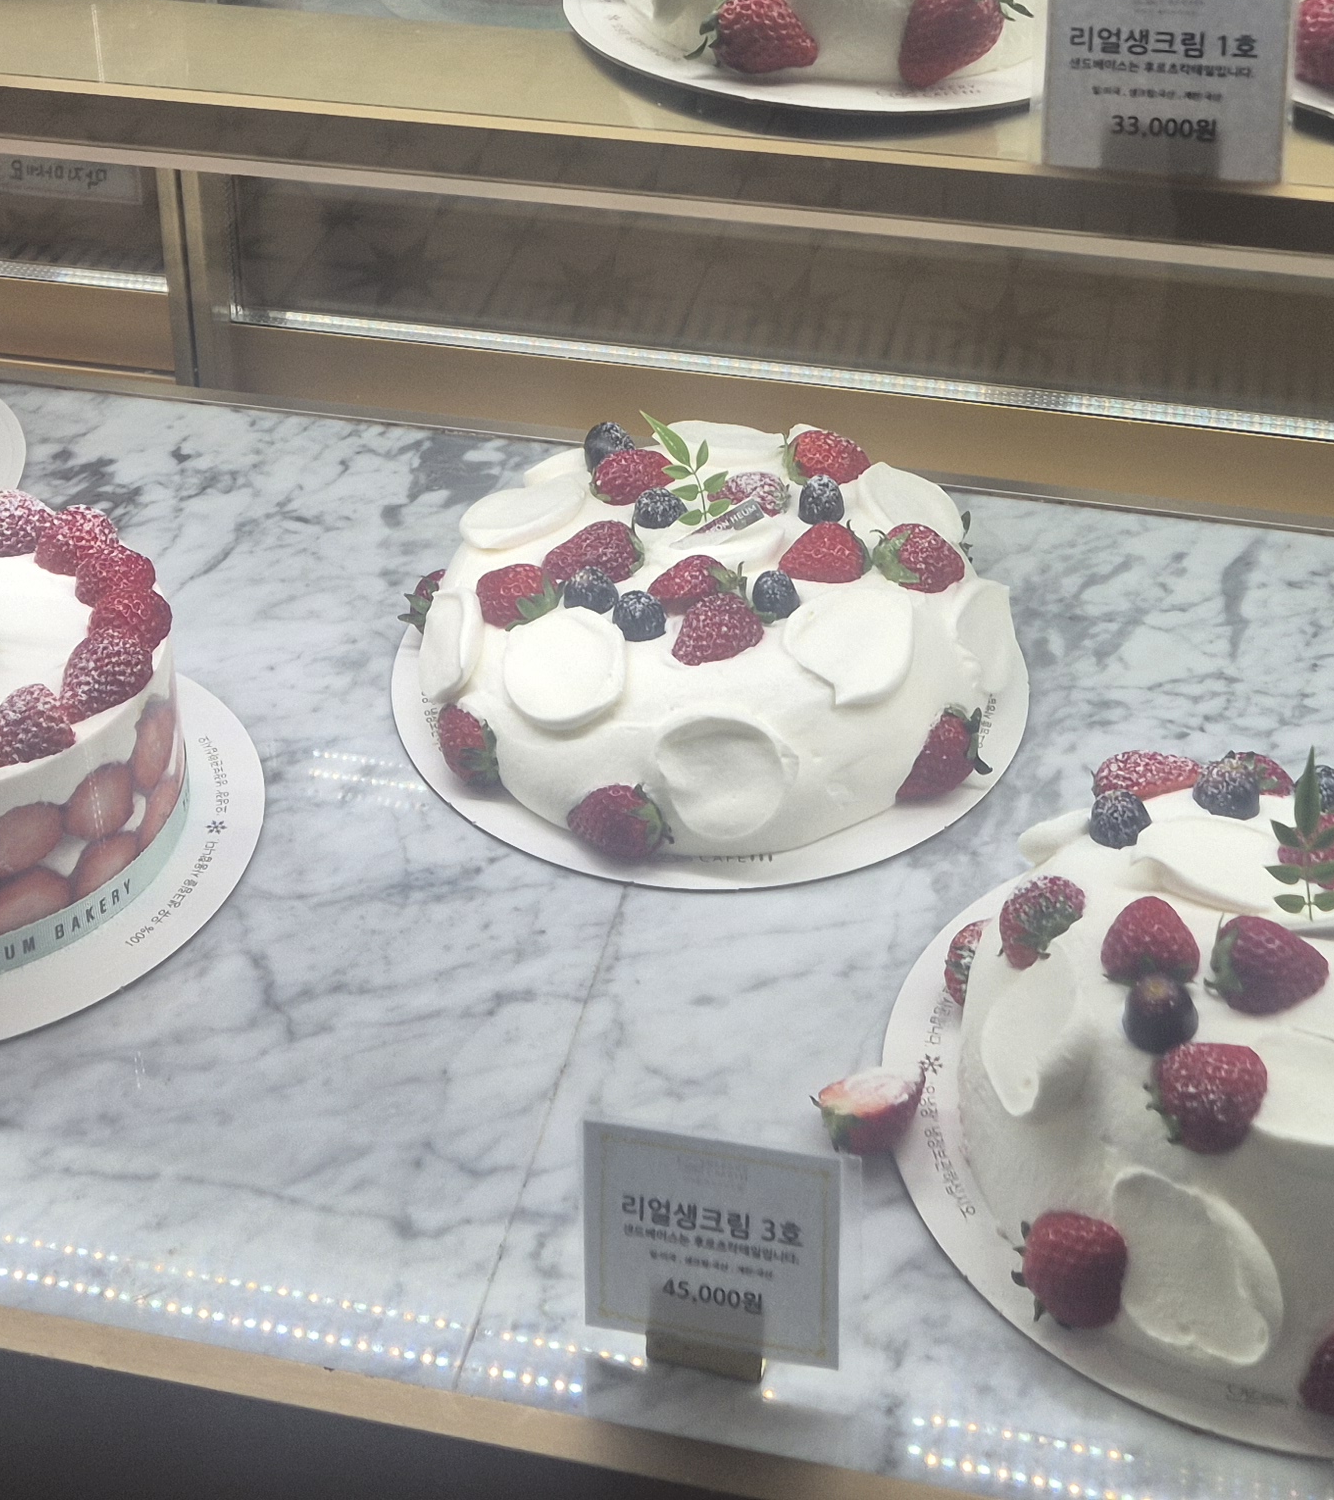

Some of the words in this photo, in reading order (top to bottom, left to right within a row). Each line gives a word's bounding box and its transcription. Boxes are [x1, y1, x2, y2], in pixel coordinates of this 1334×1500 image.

[1069, 26, 1206, 58] 리얼생크림
[1217, 34, 1259, 59] 1호
[1110, 114, 1217, 143] 33,000원
[730, 503, 758, 524] HEUM
[52, 877, 134, 941] BAKERY
[124, 924, 154, 947] 100%
[151, 908, 172, 925] 우유
[167, 878, 198, 909] 생크림을
[191, 840, 219, 878] 사용합니다.
[620, 1193, 751, 1241] 리얼생크림
[761, 1219, 804, 1248] 3호
[661, 1277, 764, 1316] 45,000원
